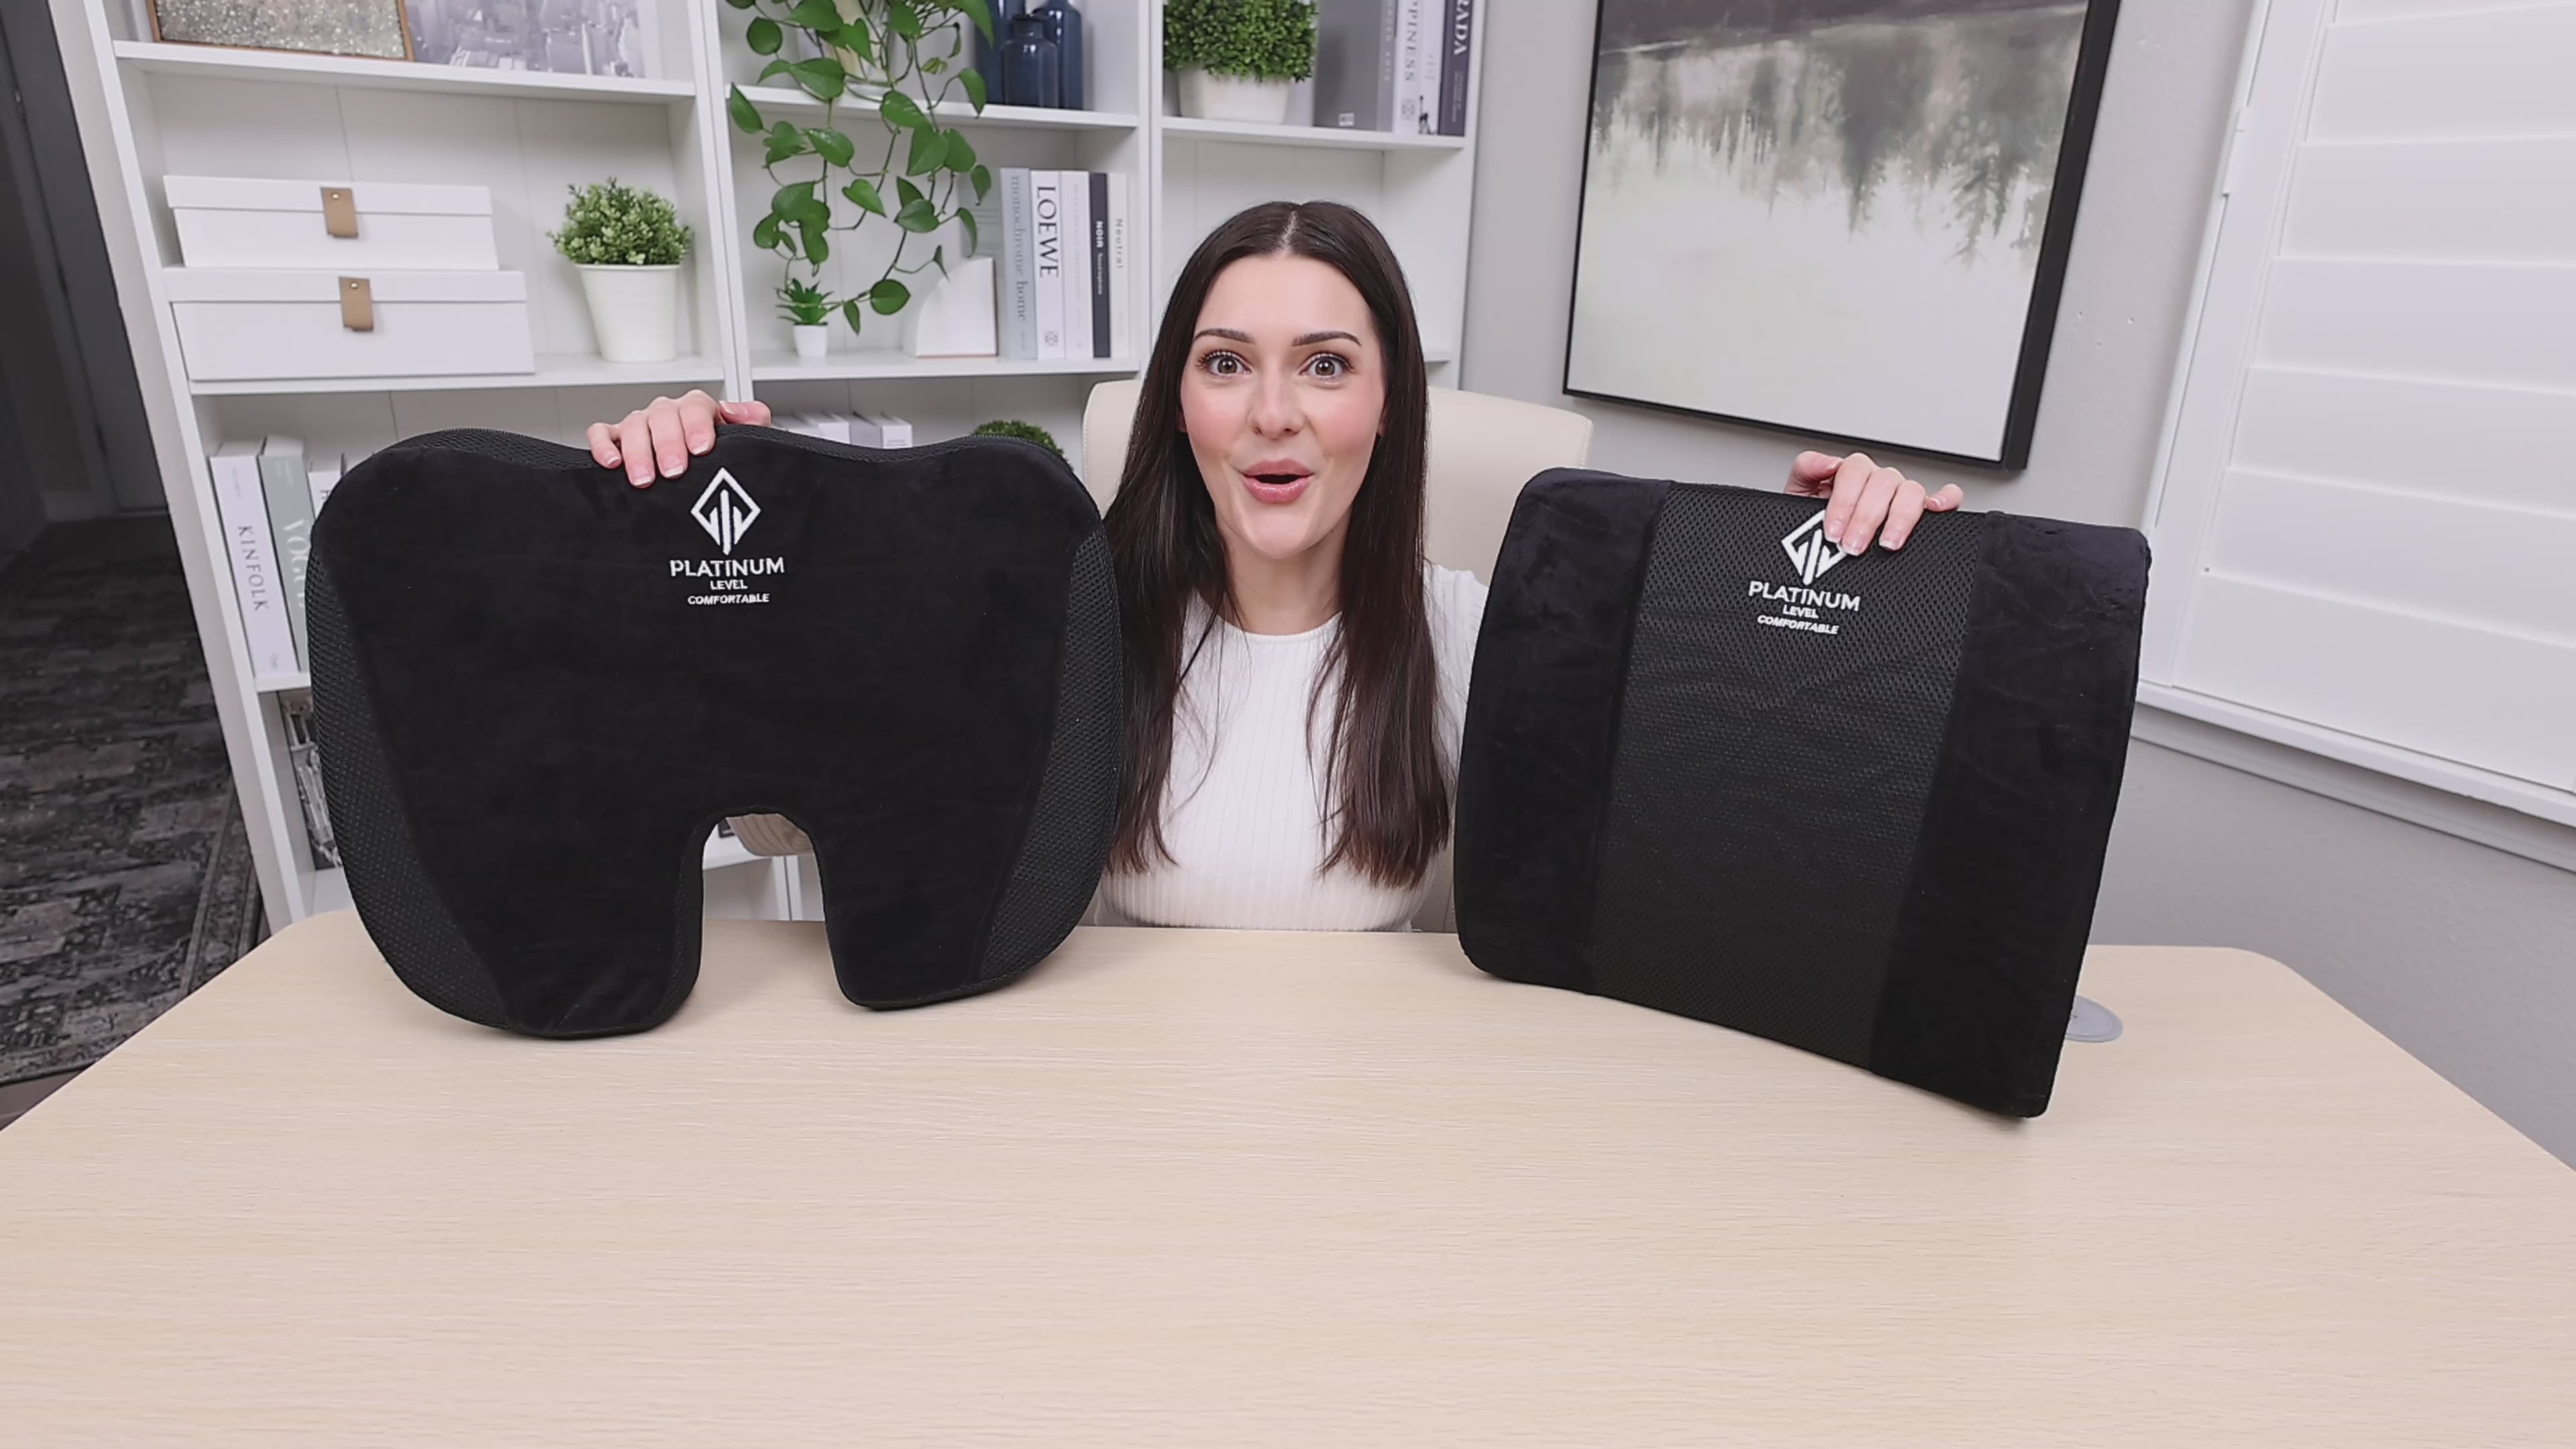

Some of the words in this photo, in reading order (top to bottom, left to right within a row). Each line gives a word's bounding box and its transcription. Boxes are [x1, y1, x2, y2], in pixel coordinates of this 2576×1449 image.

[1011, 176, 1026, 276] monochrome
[1036, 186, 1059, 278] LOEWE
[1095, 220, 1104, 248] NOIR
[1016, 281, 1028, 321] home
[237, 525, 270, 612] KINFOLK
[669, 557, 785, 578] PLATINUM
[710, 579, 748, 590] LEVEL
[1748, 580, 1861, 612] PLATINUM
[687, 593, 769, 605] COMFORTABLE
[1782, 604, 1819, 619] LEVEL
[1757, 614, 1839, 635] COMFORTABLE
